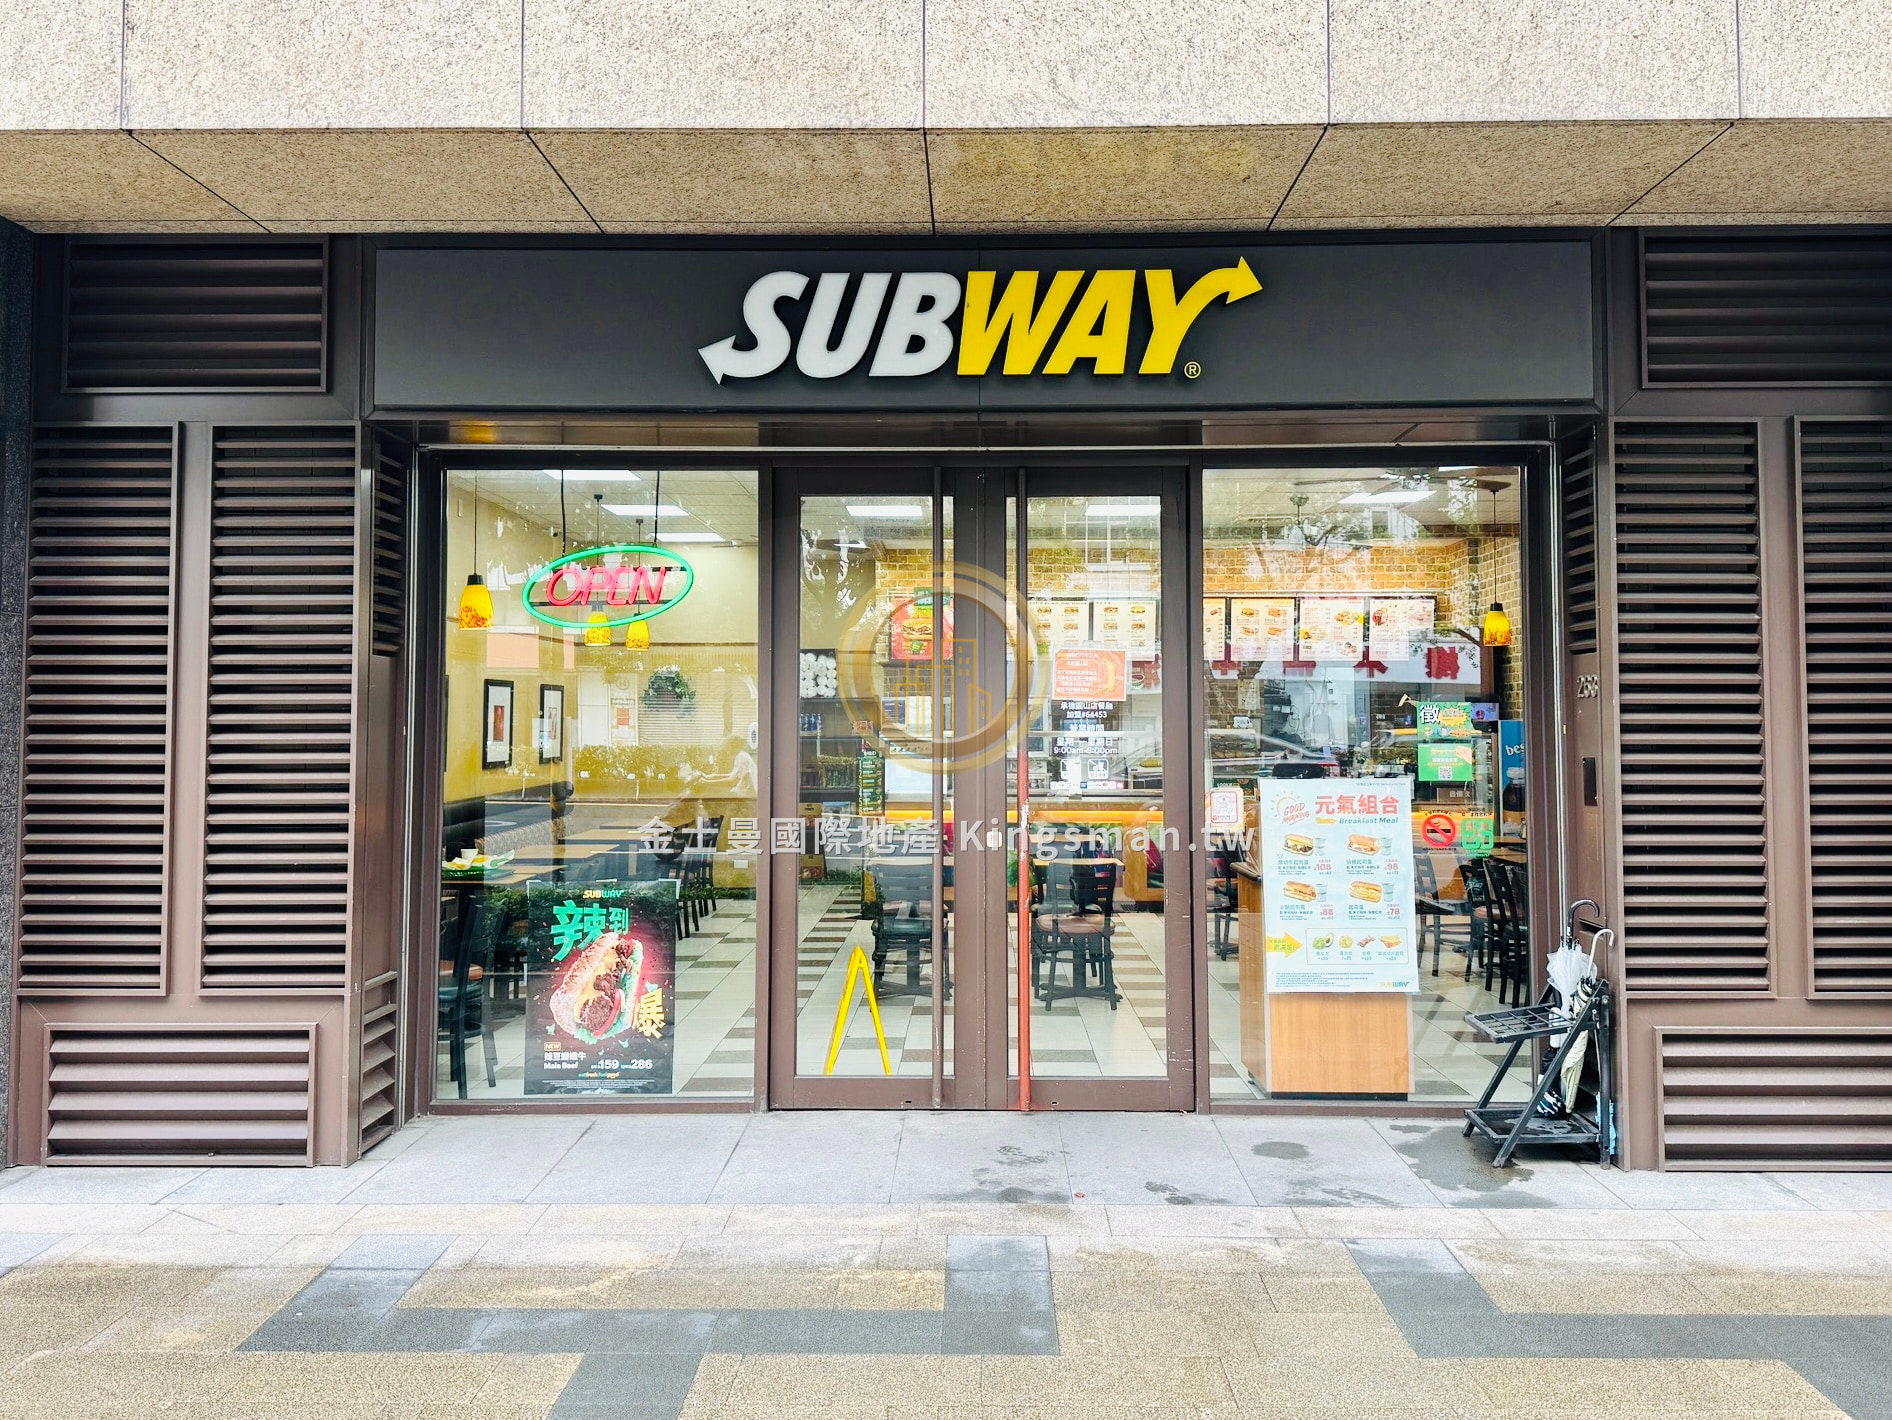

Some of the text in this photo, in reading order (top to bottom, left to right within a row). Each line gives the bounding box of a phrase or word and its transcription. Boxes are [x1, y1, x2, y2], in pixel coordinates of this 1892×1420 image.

[698, 256, 1263, 384] SUBWAY
[546, 565, 667, 606] OPEN
[1283, 803, 1305, 816] GOOD
[1315, 794, 1399, 815] 元氣組合
[583, 889, 624, 899] SUBWAY
[599, 1059, 619, 1070] 159
[631, 1059, 653, 1070] 286
